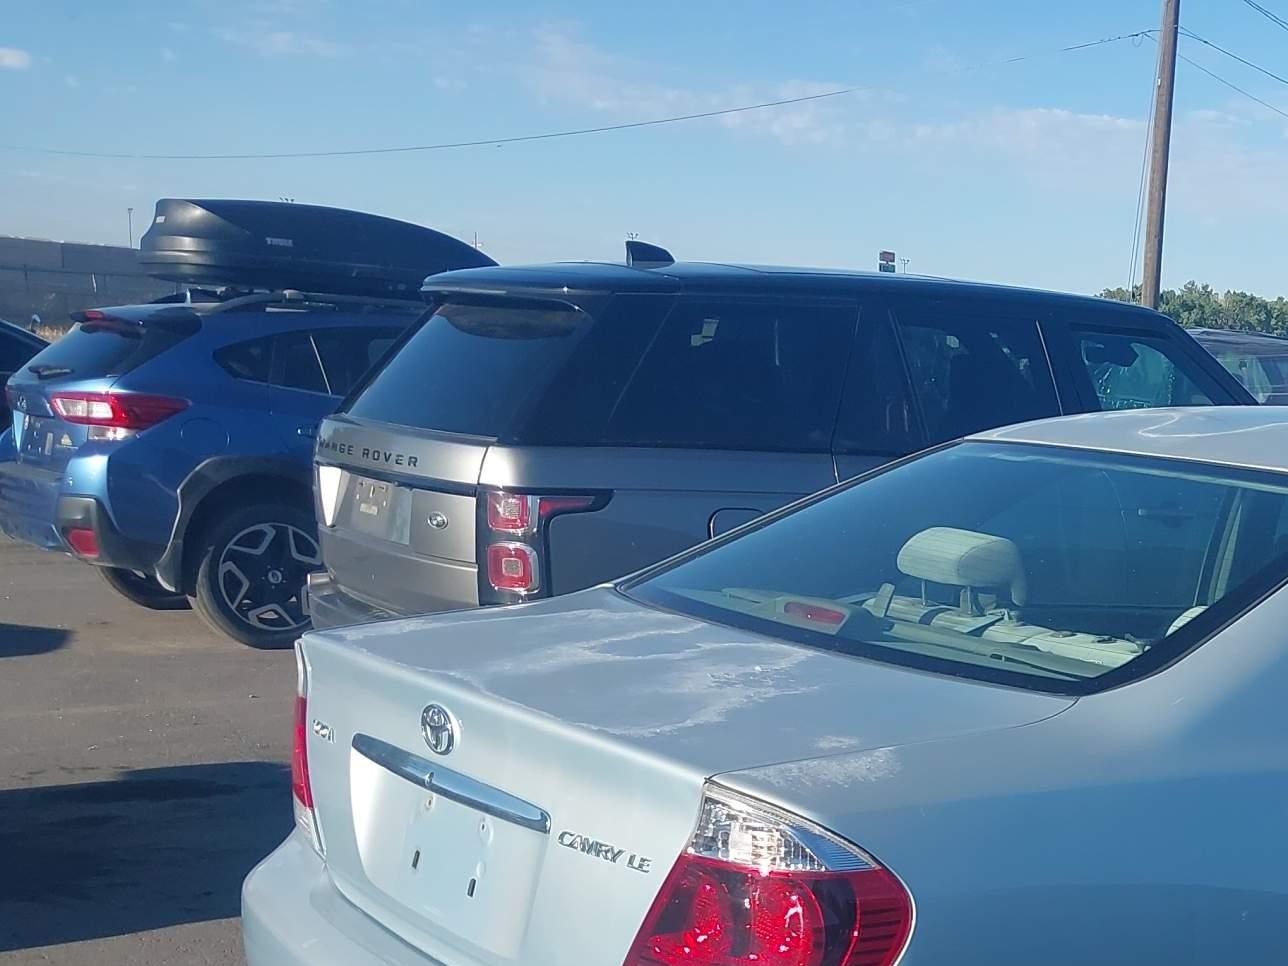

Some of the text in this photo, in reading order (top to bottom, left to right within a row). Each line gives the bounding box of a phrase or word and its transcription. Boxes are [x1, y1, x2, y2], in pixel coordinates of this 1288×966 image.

[362, 447, 418, 468] ROVER
[558, 831, 652, 873] CAMRY LE
